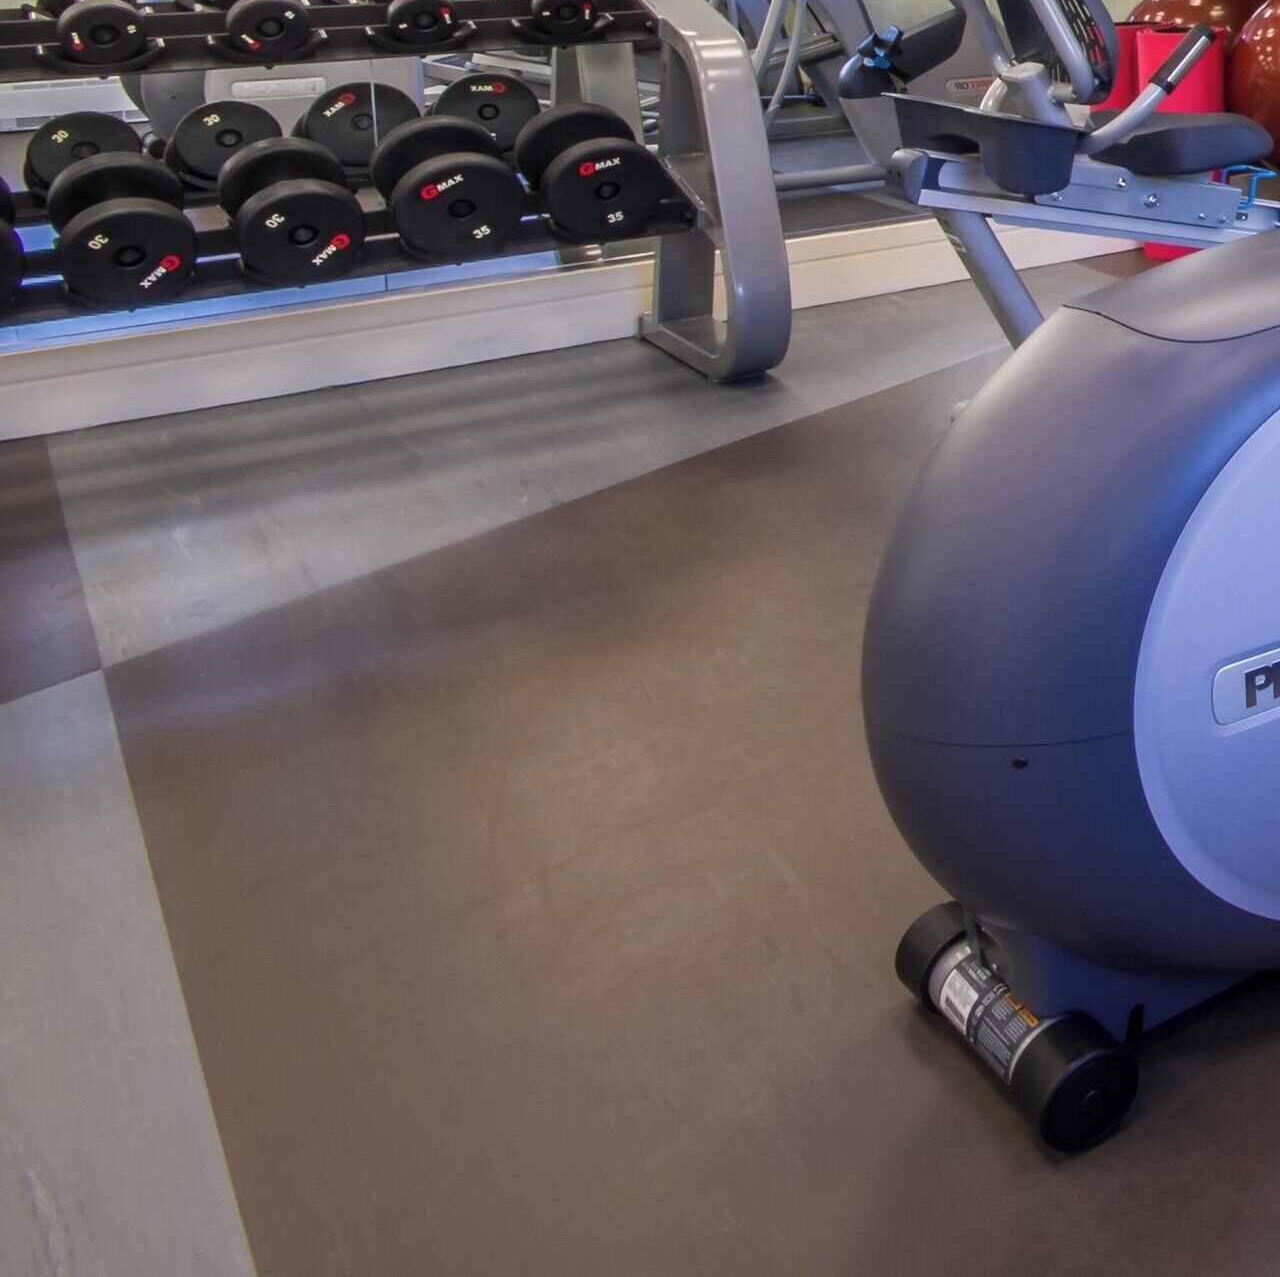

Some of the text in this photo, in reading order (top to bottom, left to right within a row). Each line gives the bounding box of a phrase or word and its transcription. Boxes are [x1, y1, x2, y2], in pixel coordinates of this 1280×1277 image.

[264, 213, 285, 229] 30
[607, 211, 625, 224] 35
[472, 225, 491, 240] 35
[87, 233, 109, 251] 30
